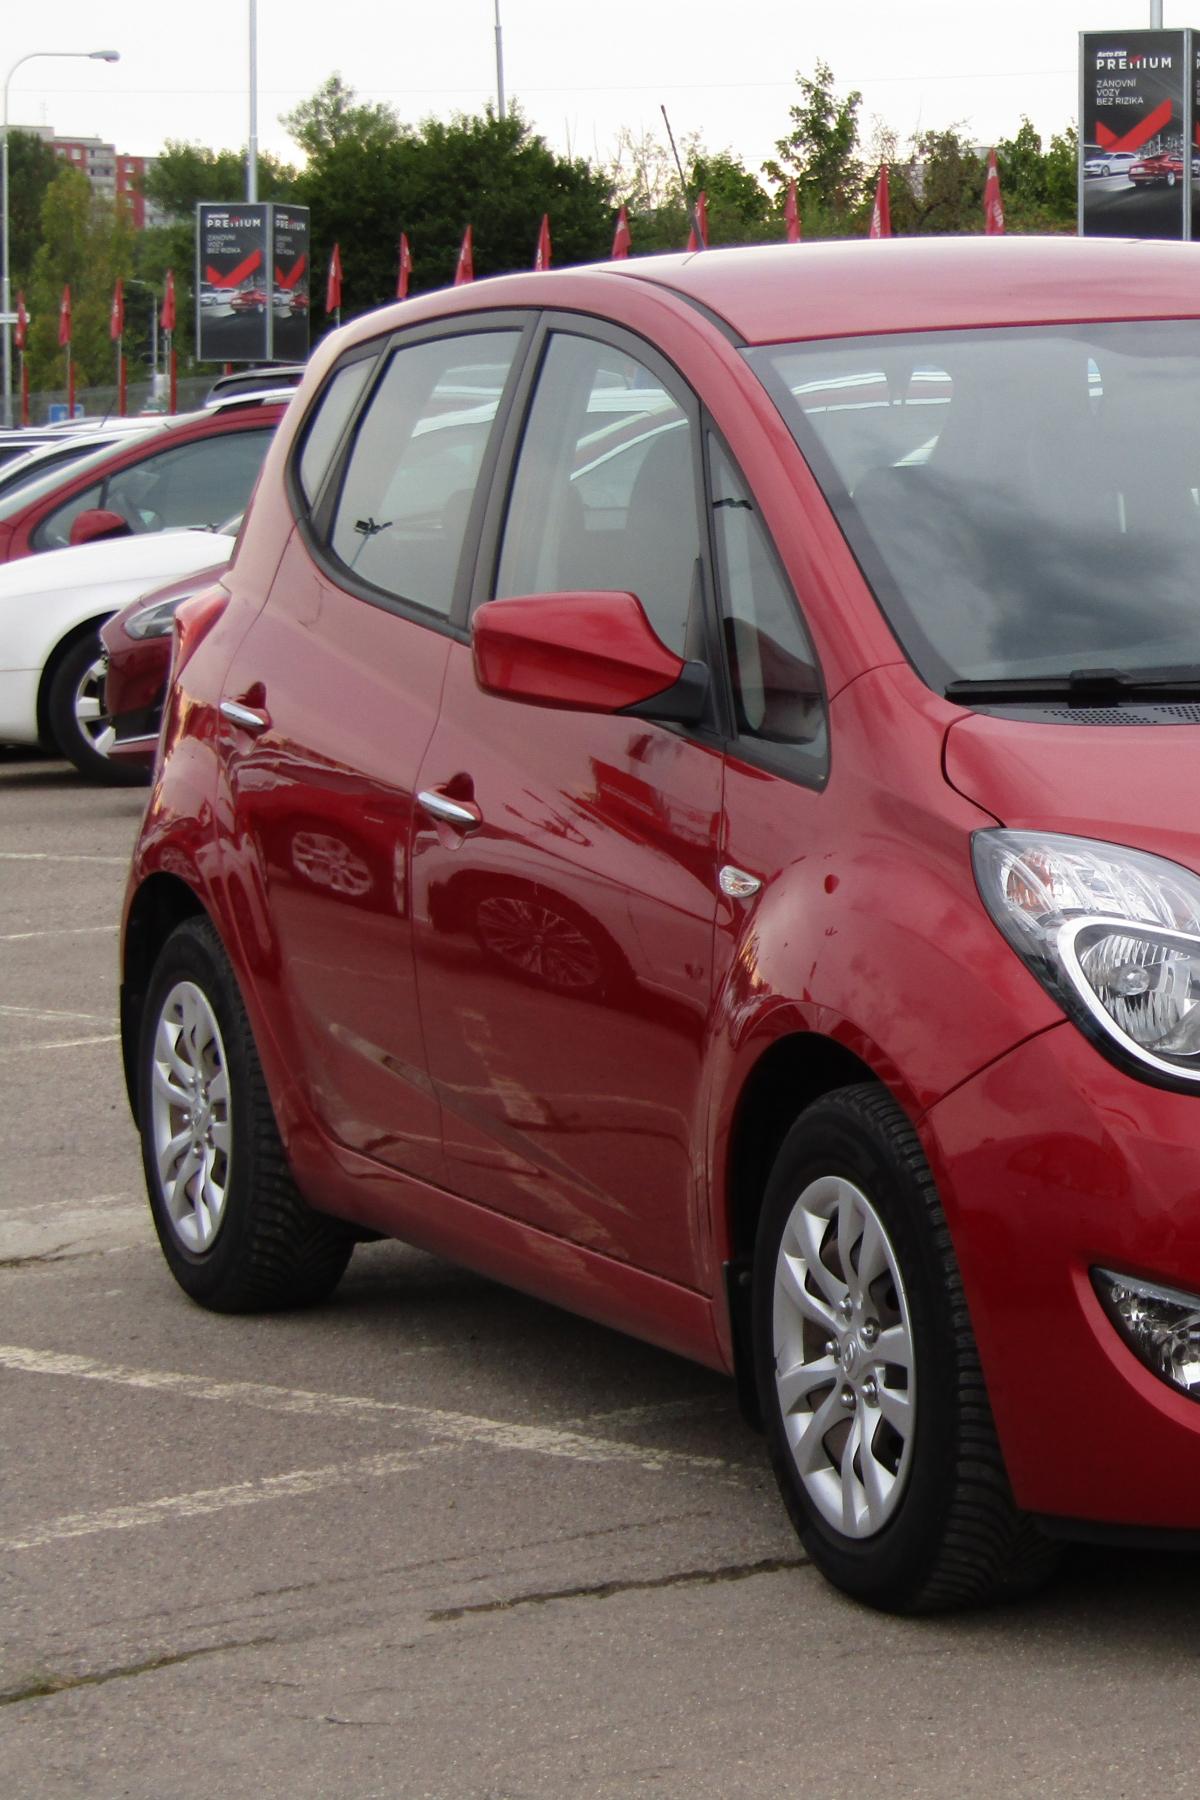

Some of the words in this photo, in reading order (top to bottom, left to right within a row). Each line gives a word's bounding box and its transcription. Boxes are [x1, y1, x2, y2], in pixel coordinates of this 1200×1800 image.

[1096, 57, 1172, 70] PREMIUM
[1096, 88, 1120, 97] VOZY
[1096, 97, 1113, 106] BEZ
[1115, 96, 1144, 105] RIZIKA
[207, 218, 261, 228] PREMIUM
